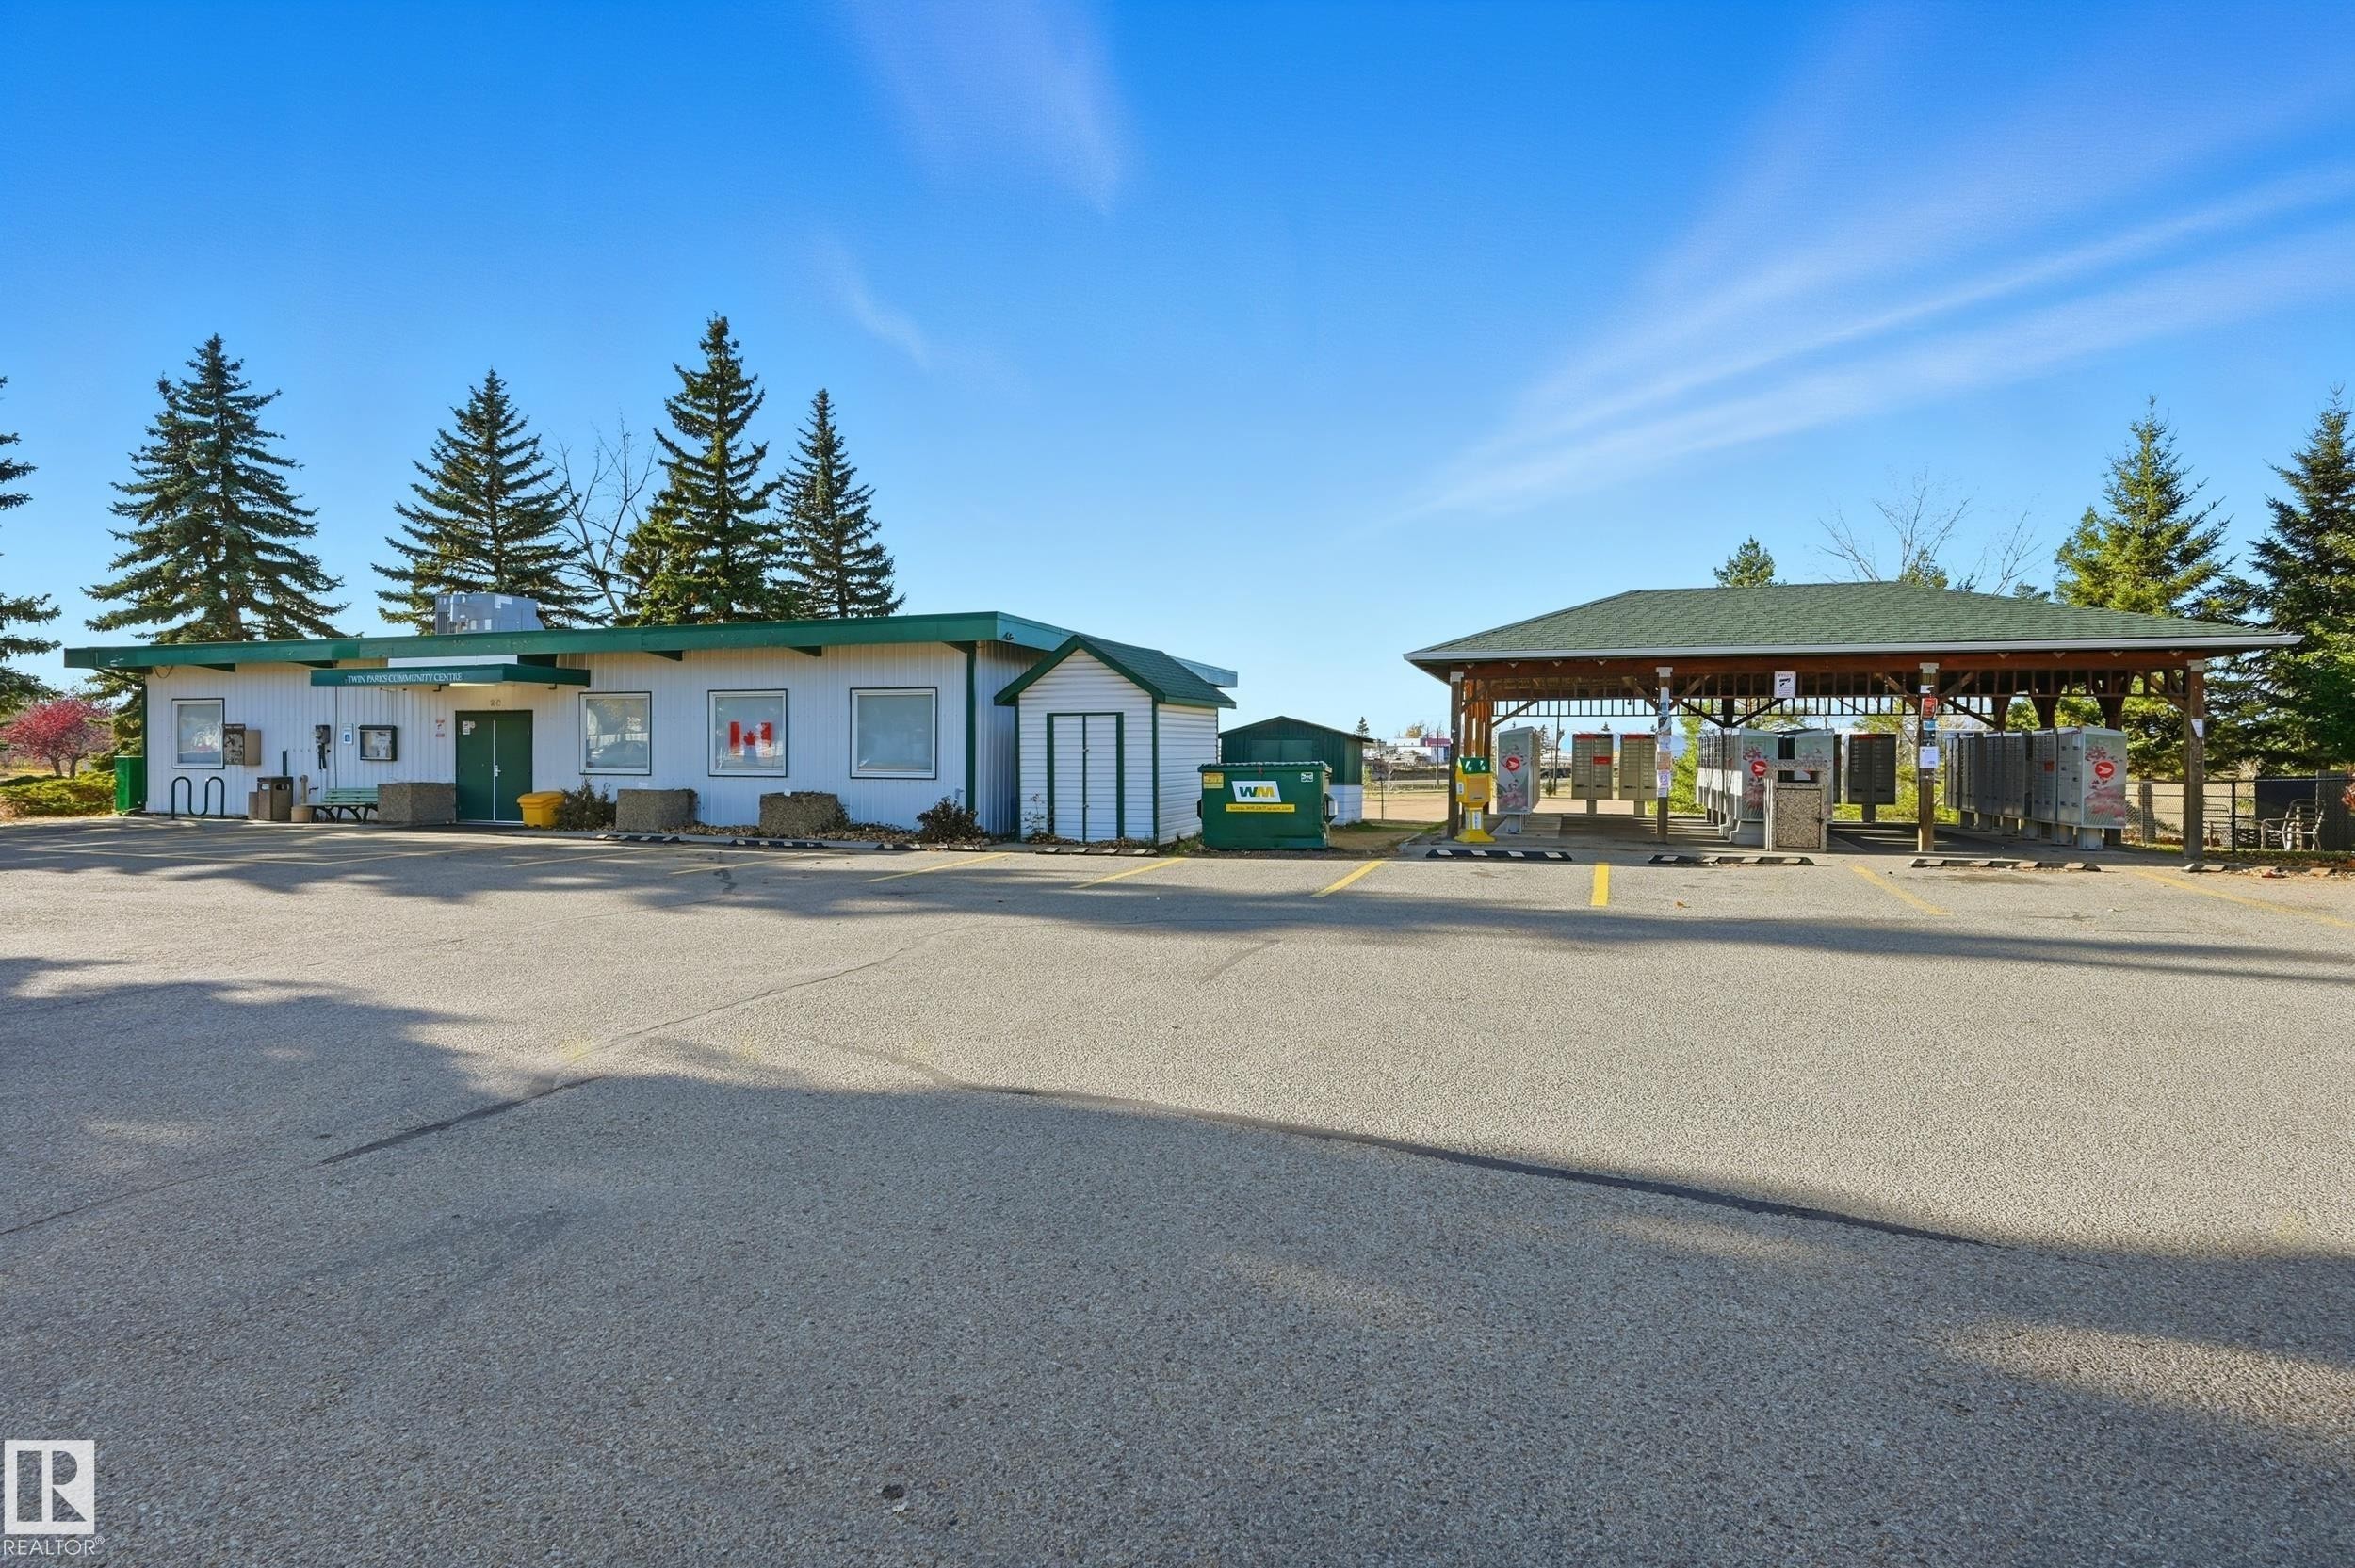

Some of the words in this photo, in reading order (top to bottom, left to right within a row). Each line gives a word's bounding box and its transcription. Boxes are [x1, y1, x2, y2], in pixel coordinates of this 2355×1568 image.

[347, 674, 365, 684] TWIN
[366, 674, 388, 684] PARKS
[388, 673, 433, 683] COMMUNITY
[1239, 786, 1275, 798] WM
